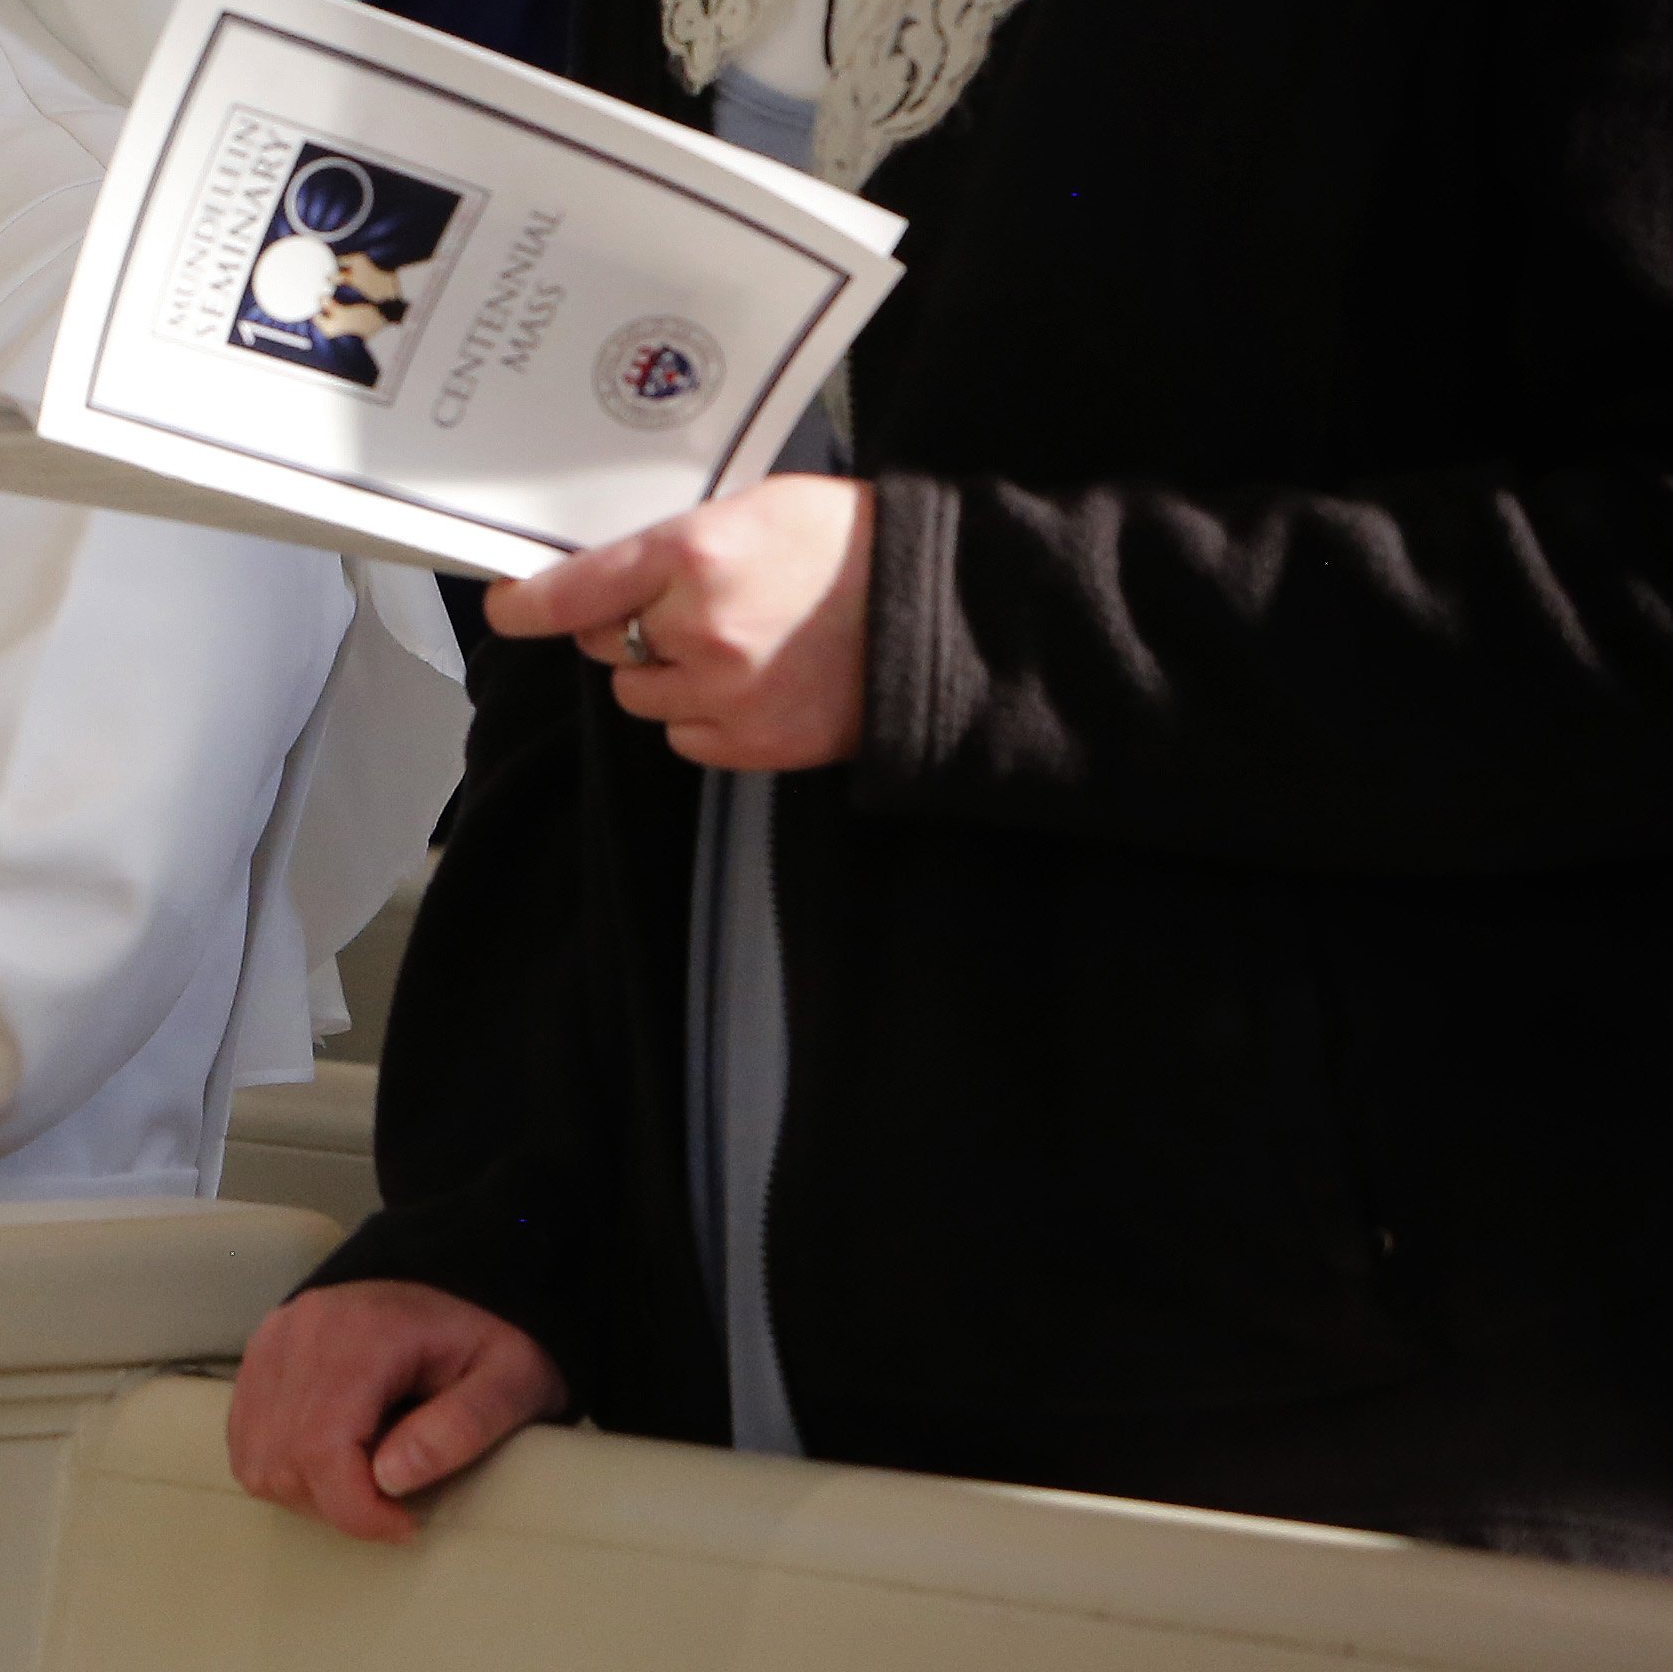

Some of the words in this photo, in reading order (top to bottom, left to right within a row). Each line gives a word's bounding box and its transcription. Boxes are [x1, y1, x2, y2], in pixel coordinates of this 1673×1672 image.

[197, 126, 290, 338] SEMINARY
[431, 209, 566, 429] CENTENNIAL
[500, 285, 566, 375] MASS
